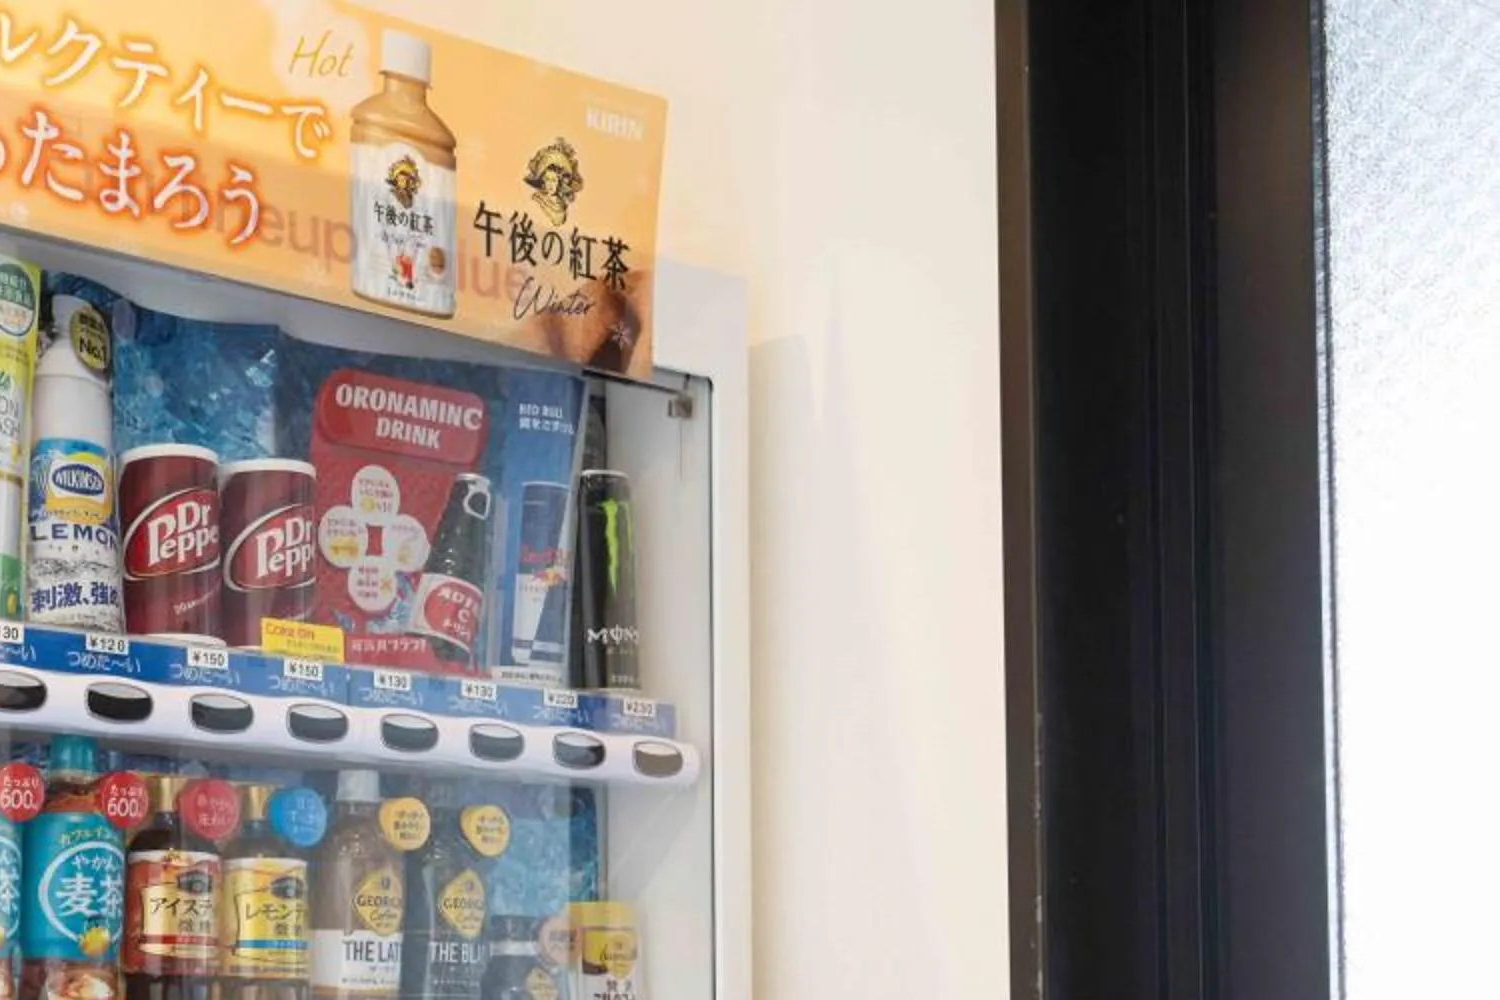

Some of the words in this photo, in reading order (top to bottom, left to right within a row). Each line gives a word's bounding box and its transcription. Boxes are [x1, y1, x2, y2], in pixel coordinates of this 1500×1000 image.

[288, 30, 356, 79] Hot
[585, 106, 645, 143] KIRIN
[472, 201, 631, 291] 午後の紅茶
[512, 275, 596, 321] Winter
[376, 416, 441, 449] DRINK
[177, 500, 212, 531] Dr
[285, 516, 313, 542] Dr
[146, 513, 219, 567] Peppe
[254, 527, 315, 579] Pepp
[88, 637, 126, 653] ¥120
[191, 651, 226, 667] ¥150
[55, 873, 122, 918] 麦茶
[342, 939, 375, 963] THE
[377, 940, 401, 963] LAT
[428, 941, 459, 963] THE
